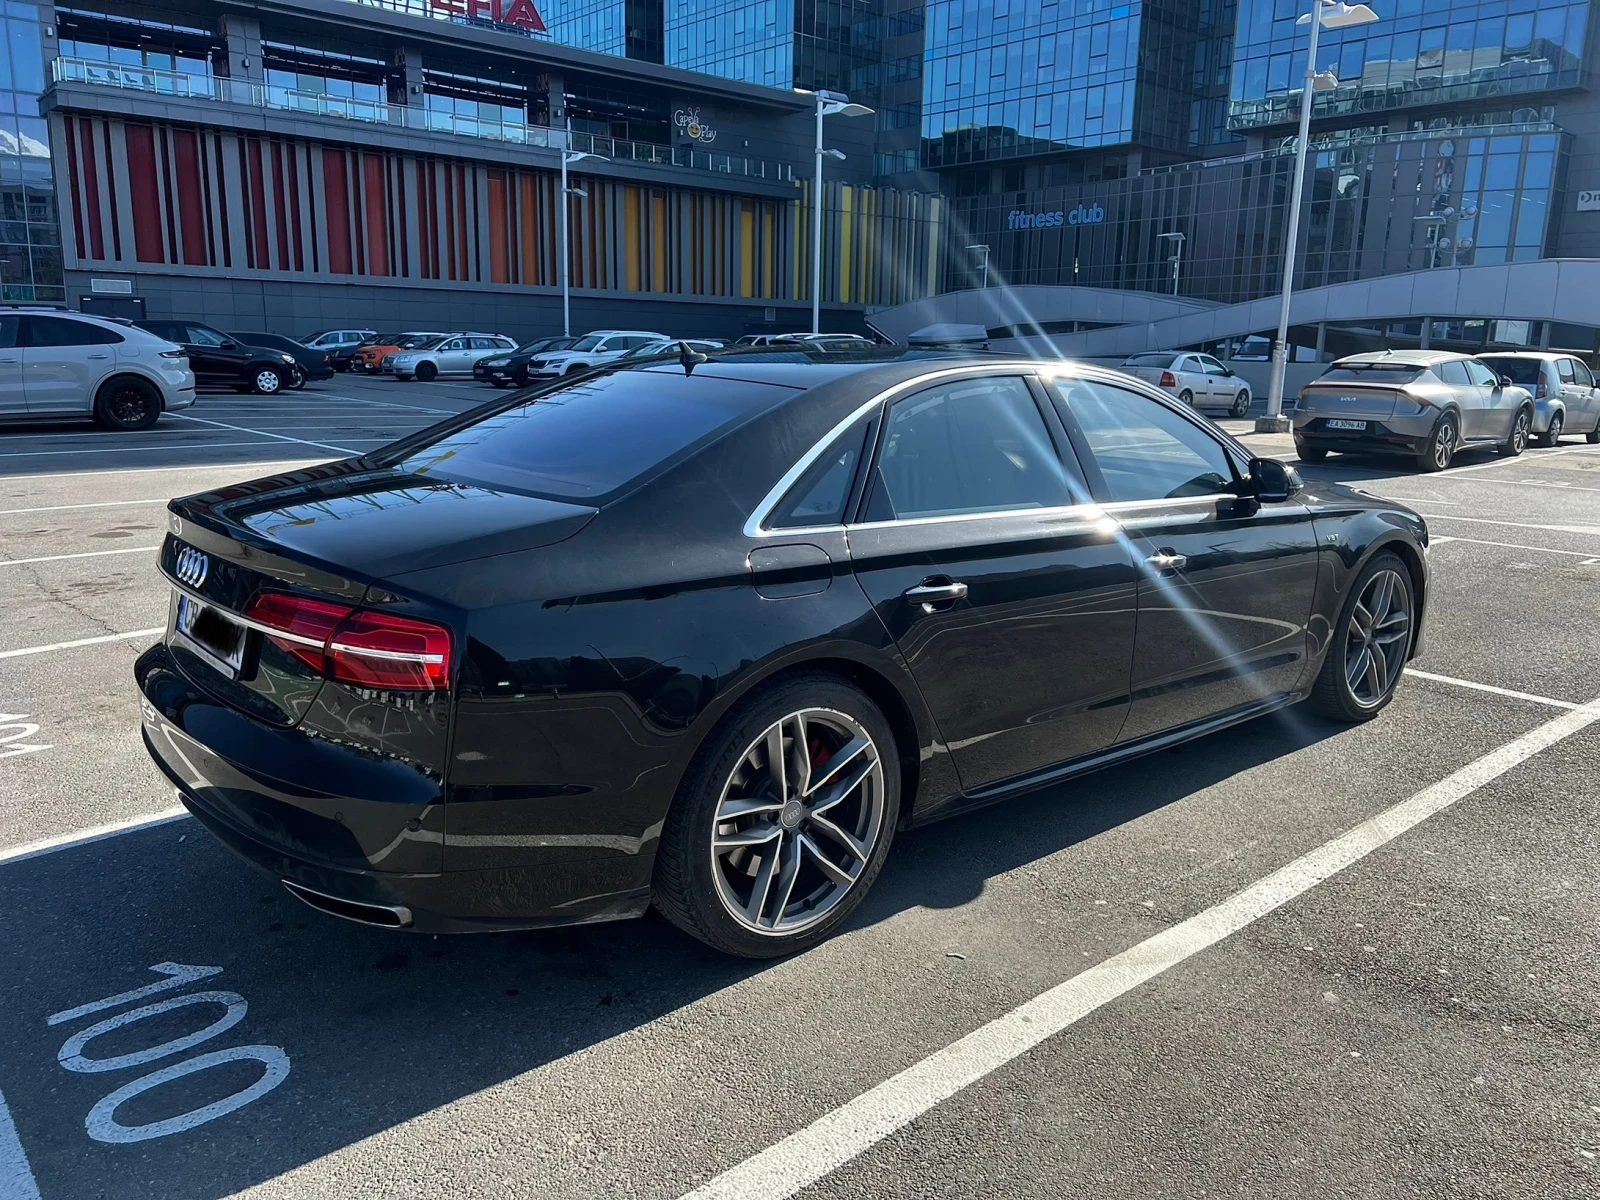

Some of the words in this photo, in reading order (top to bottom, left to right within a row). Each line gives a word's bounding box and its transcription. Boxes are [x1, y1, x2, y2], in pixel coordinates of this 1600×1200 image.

[699, 124, 717, 142] Play
[1008, 210, 1063, 229] fitness
[1068, 203, 1104, 224] club
[46, 961, 291, 1144] 100
